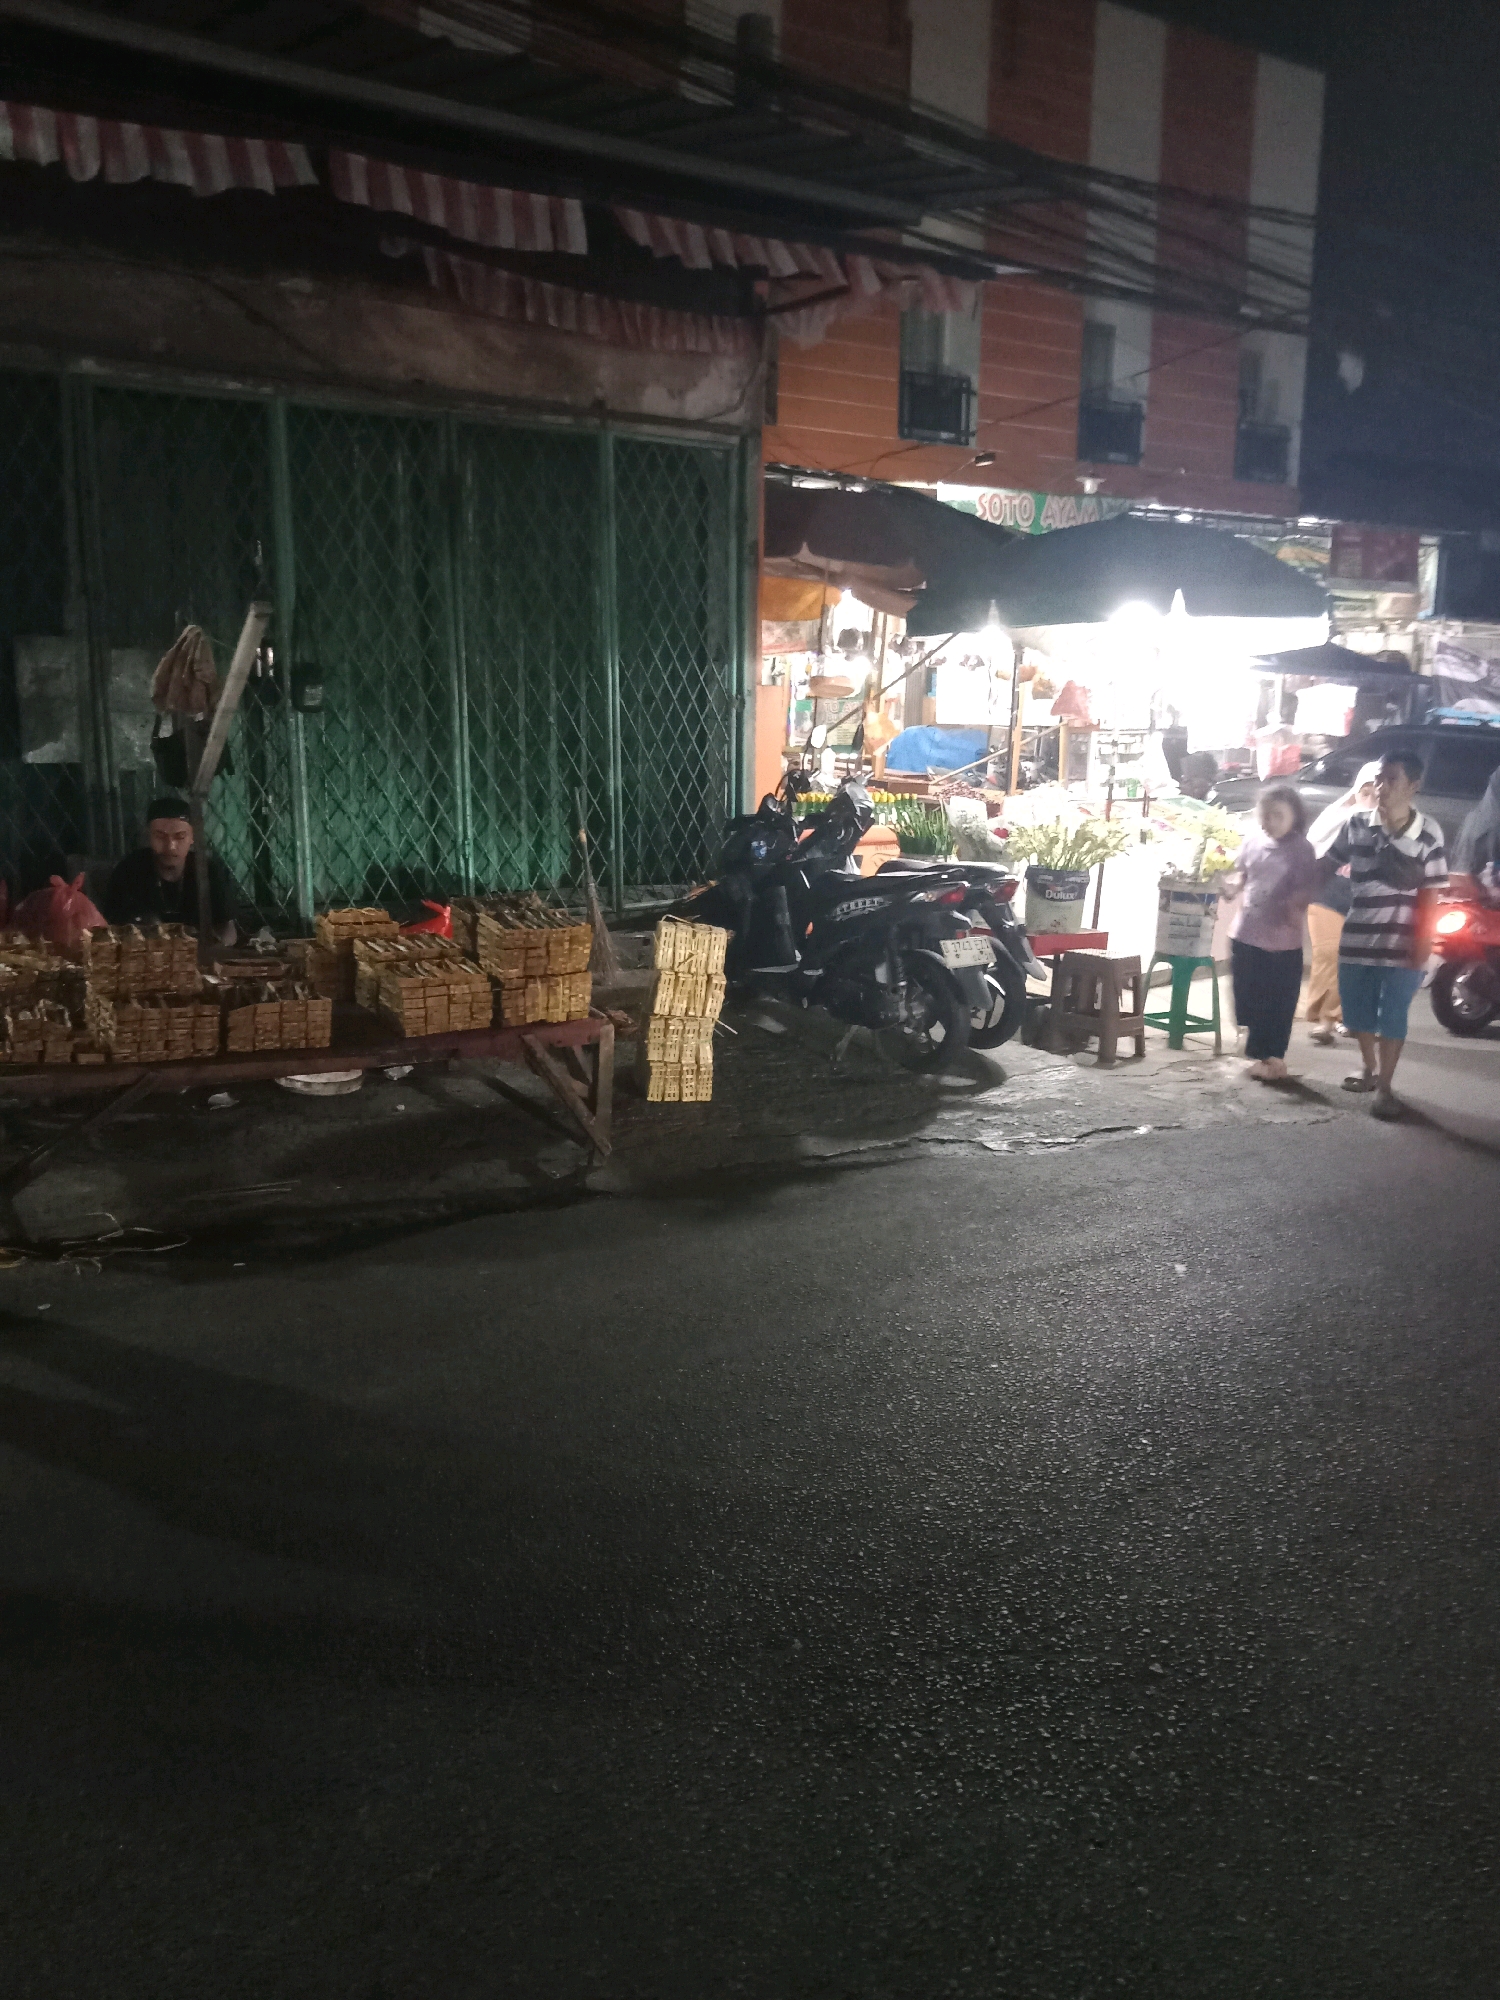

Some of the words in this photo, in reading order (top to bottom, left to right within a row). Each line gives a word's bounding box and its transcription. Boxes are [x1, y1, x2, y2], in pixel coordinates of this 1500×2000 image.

[976, 493, 1035, 525] SOTO
[1040, 494, 1099, 528] AYAM
[1045, 889, 1076, 900] Dulux
